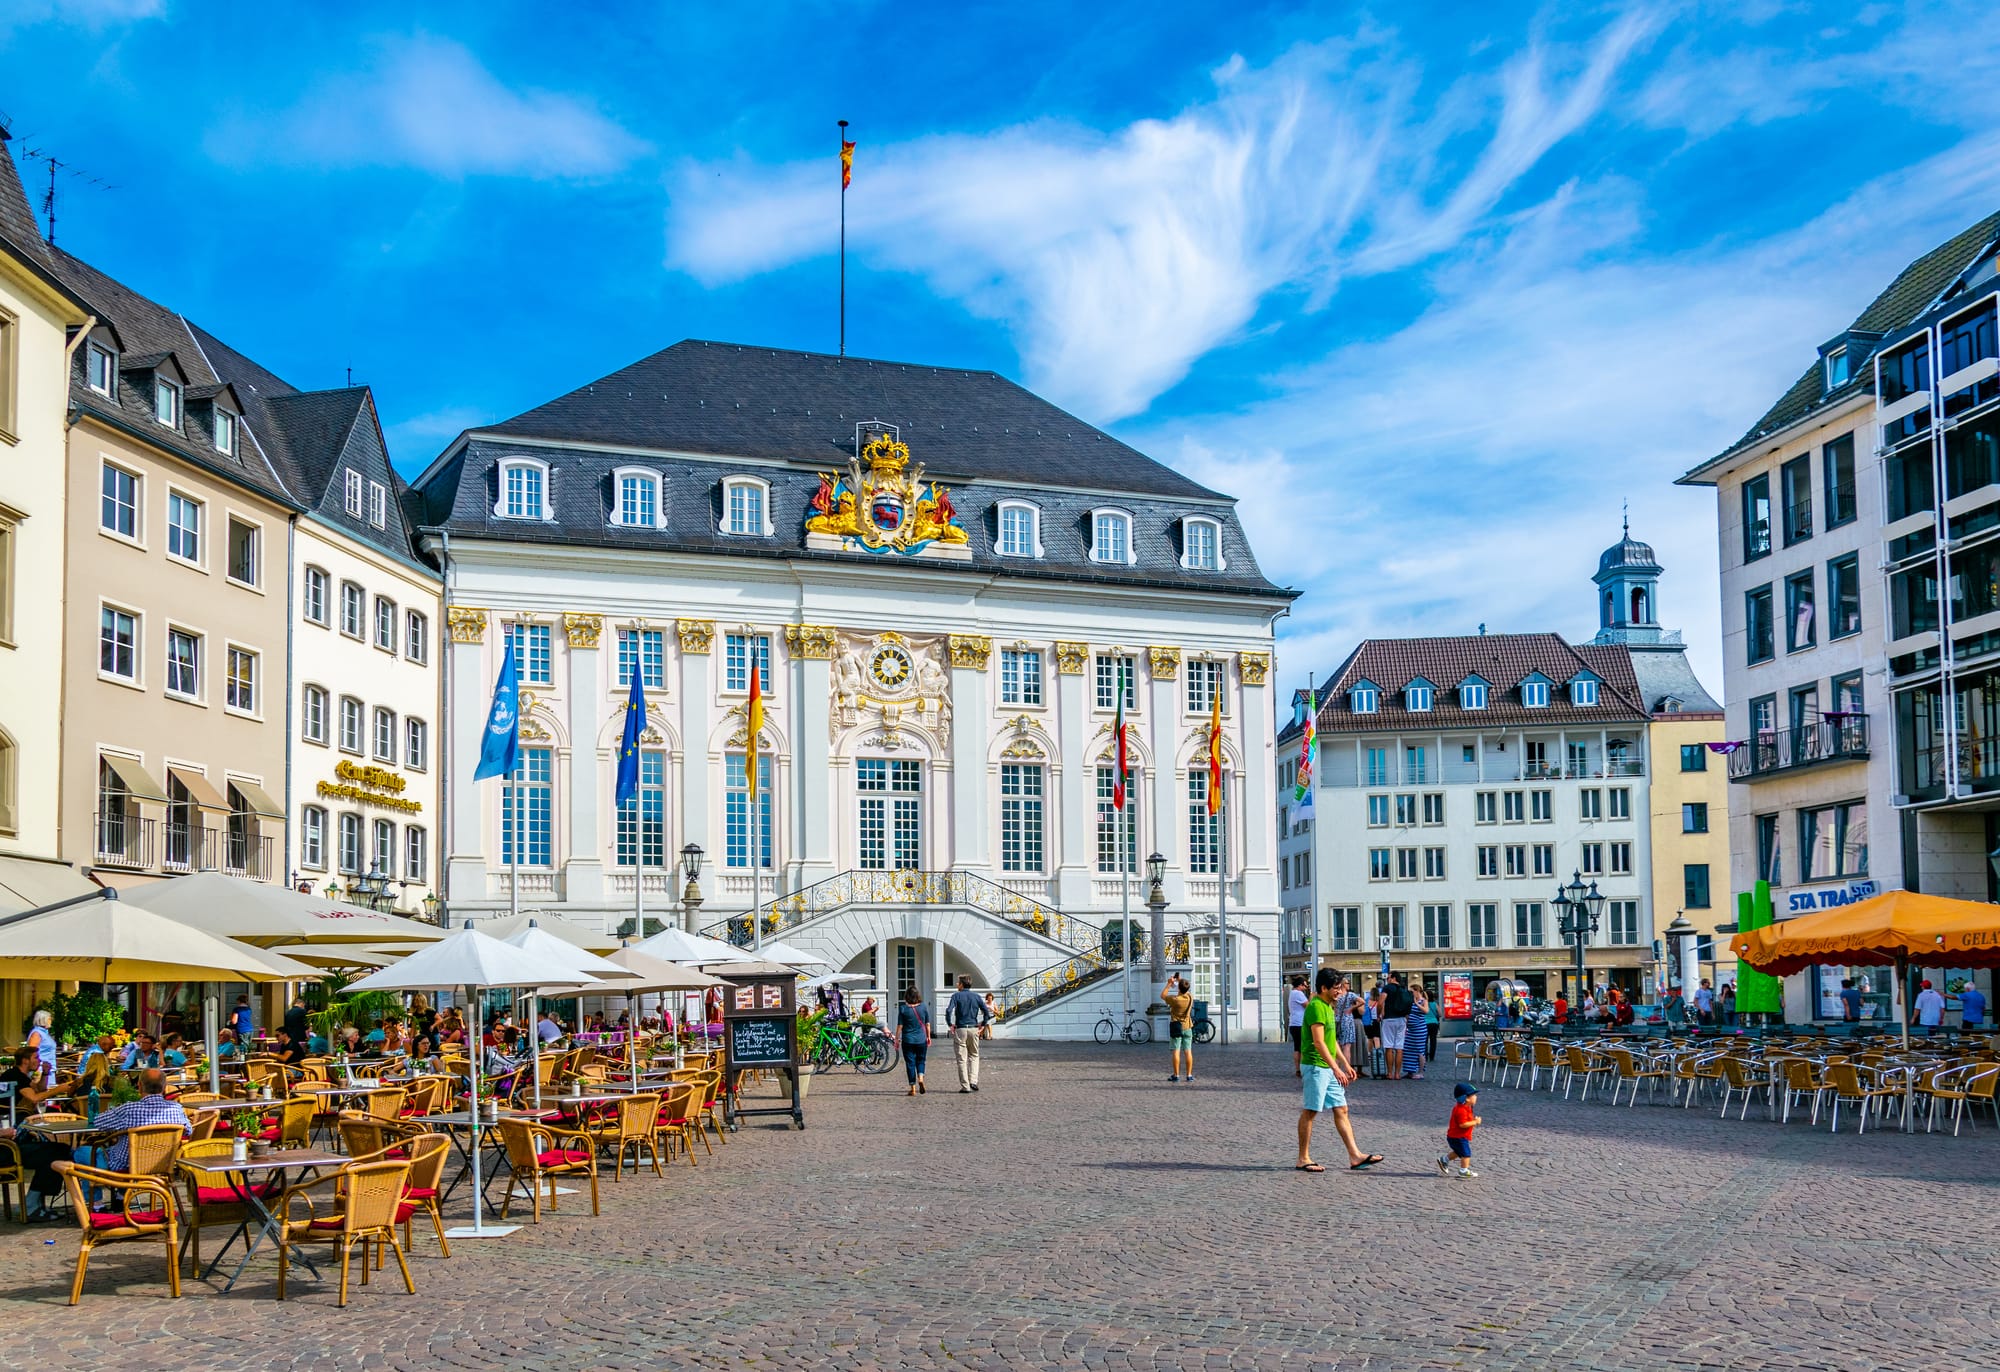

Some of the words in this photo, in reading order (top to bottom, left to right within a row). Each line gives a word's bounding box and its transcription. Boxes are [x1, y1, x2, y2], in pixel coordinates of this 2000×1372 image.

[1789, 892, 1816, 911] STA
[1782, 941, 1800, 953] La
[1805, 936, 1838, 951] Dolce
[1841, 934, 1866, 948] Vita
[1434, 956, 1487, 966] RULAND
